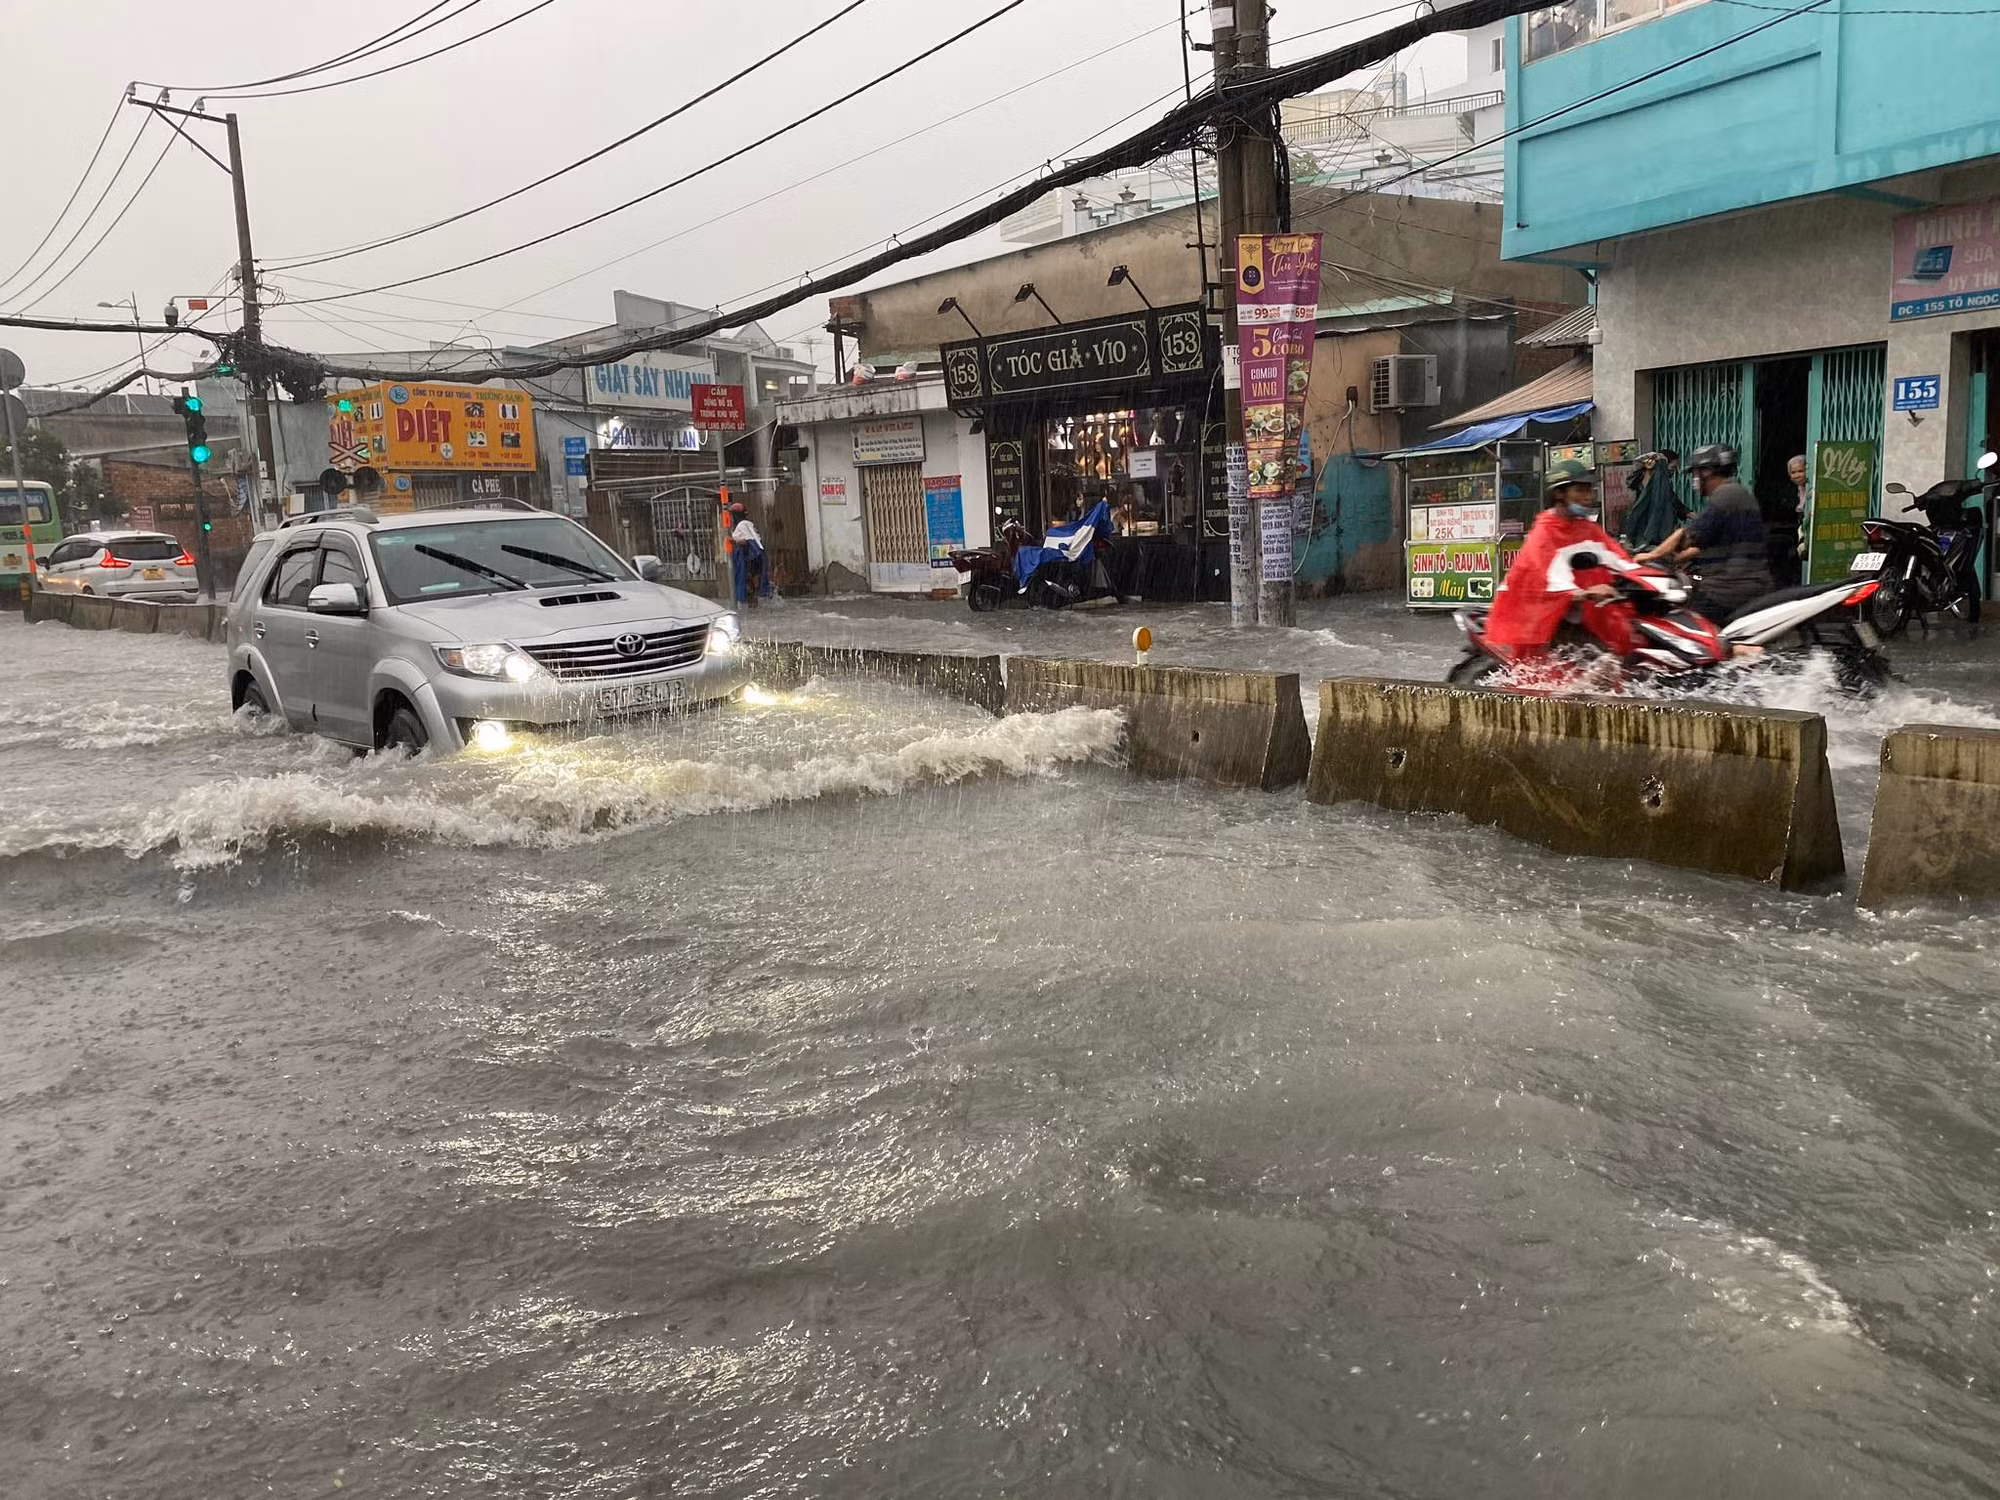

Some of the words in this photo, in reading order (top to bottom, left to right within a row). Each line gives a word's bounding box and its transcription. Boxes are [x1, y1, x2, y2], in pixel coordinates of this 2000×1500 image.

[1924, 301, 1945, 312] 155
[1252, 327, 1271, 358] 5
[951, 363, 978, 386] 153
[1006, 349, 1042, 377] TÓC
[1047, 338, 1084, 372] GIẢ
[1092, 338, 1127, 366] VIO
[1163, 331, 1199, 357] 153
[1250, 367, 1278, 380] COMBO
[1897, 380, 1937, 400] 155
[396, 400, 452, 454] DIỆT
[677, 431, 697, 448] LAN
[1435, 527, 1454, 539] 25K
[1413, 554, 1434, 573] SINH
[1454, 553, 1473, 573] RAU
[1474, 546, 1492, 573] MÁ
